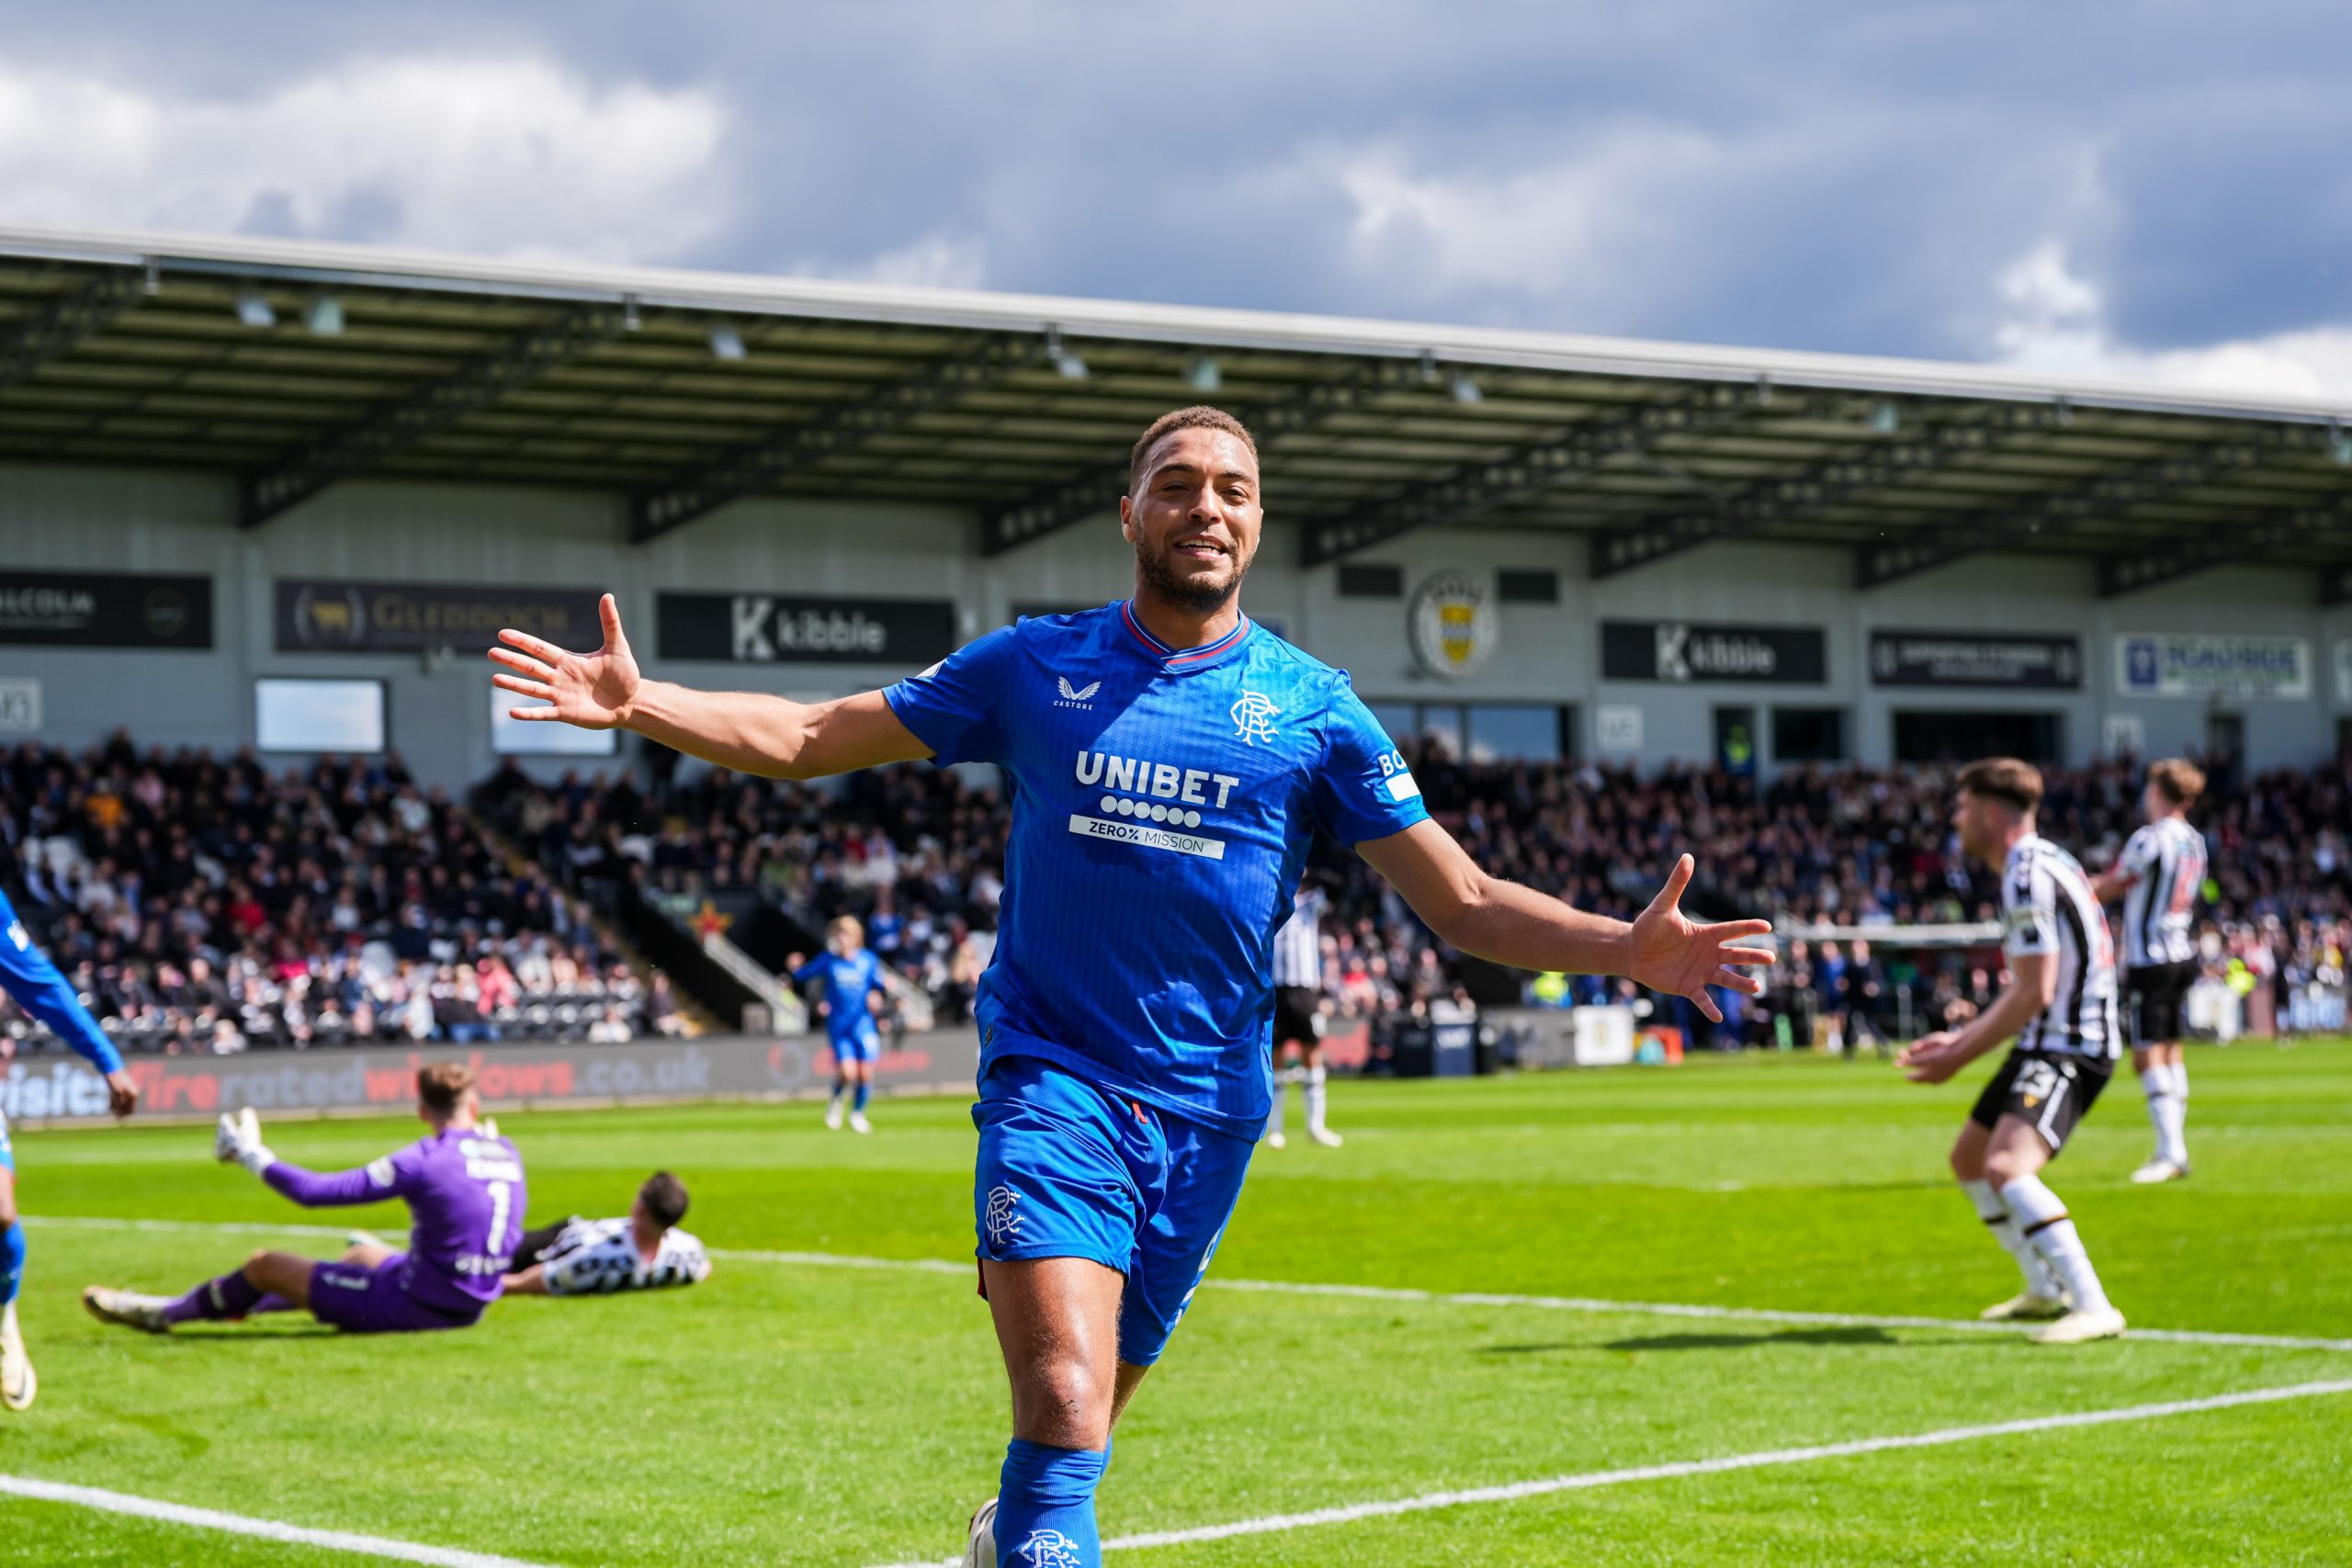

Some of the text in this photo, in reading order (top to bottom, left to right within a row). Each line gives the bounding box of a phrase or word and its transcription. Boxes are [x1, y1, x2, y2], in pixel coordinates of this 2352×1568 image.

[777, 609, 887, 652] kibble
[1053, 700, 1093, 711] CASTORE
[1076, 750, 1239, 808] UNIBET
[1089, 821, 1204, 852] ZERO% MISSION
[487, 1179, 511, 1256] 1
